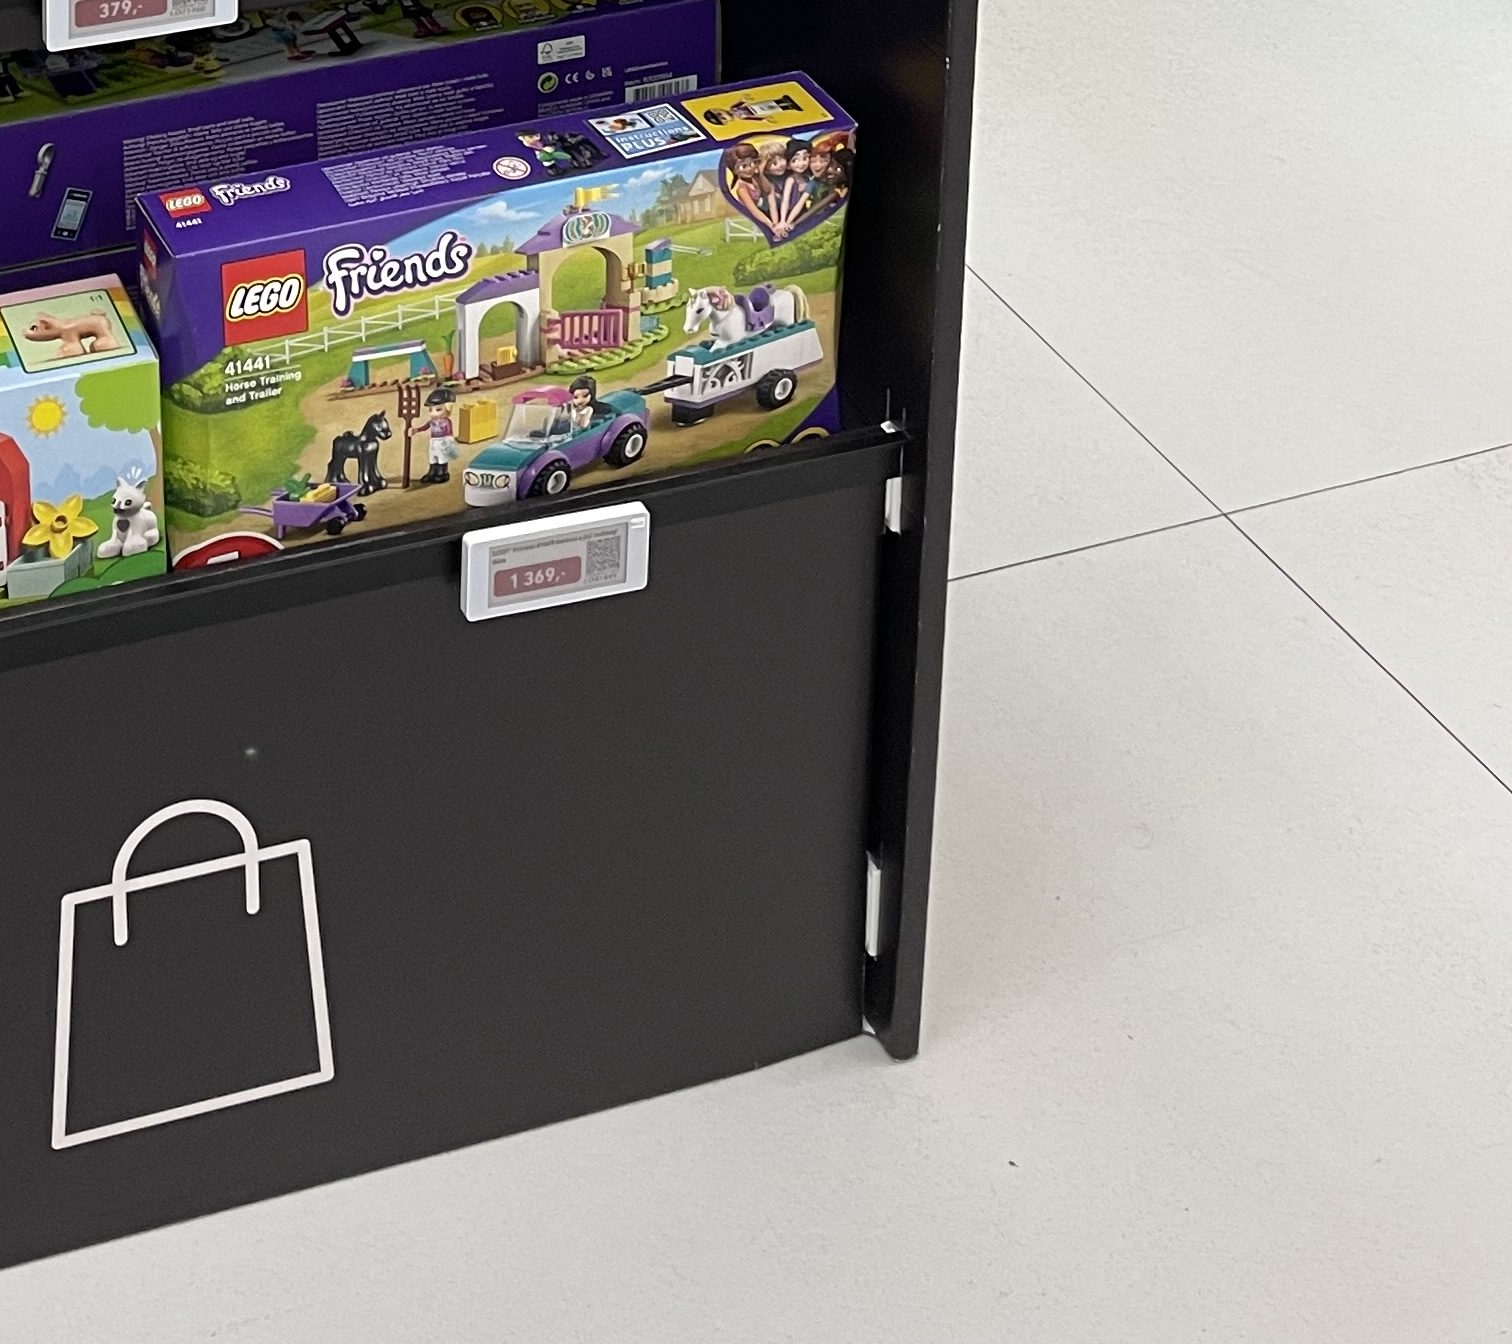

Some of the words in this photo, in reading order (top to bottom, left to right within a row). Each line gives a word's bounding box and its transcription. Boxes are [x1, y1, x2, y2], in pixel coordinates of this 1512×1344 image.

[99, 0, 143, 18] 379,-
[623, 135, 667, 153] PLUS
[166, 194, 205, 211] LEGO
[210, 175, 291, 206] Friends
[176, 217, 203, 229] 41441
[323, 231, 475, 317] Friends
[226, 274, 304, 322] LEGO
[224, 354, 271, 375] 41441
[225, 379, 257, 393] Horse
[260, 370, 302, 387] Training
[225, 393, 247, 405] and
[249, 386, 283, 403] Trailer
[510, 574, 518, 589] 1
[524, 567, 566, 585] 369,-
